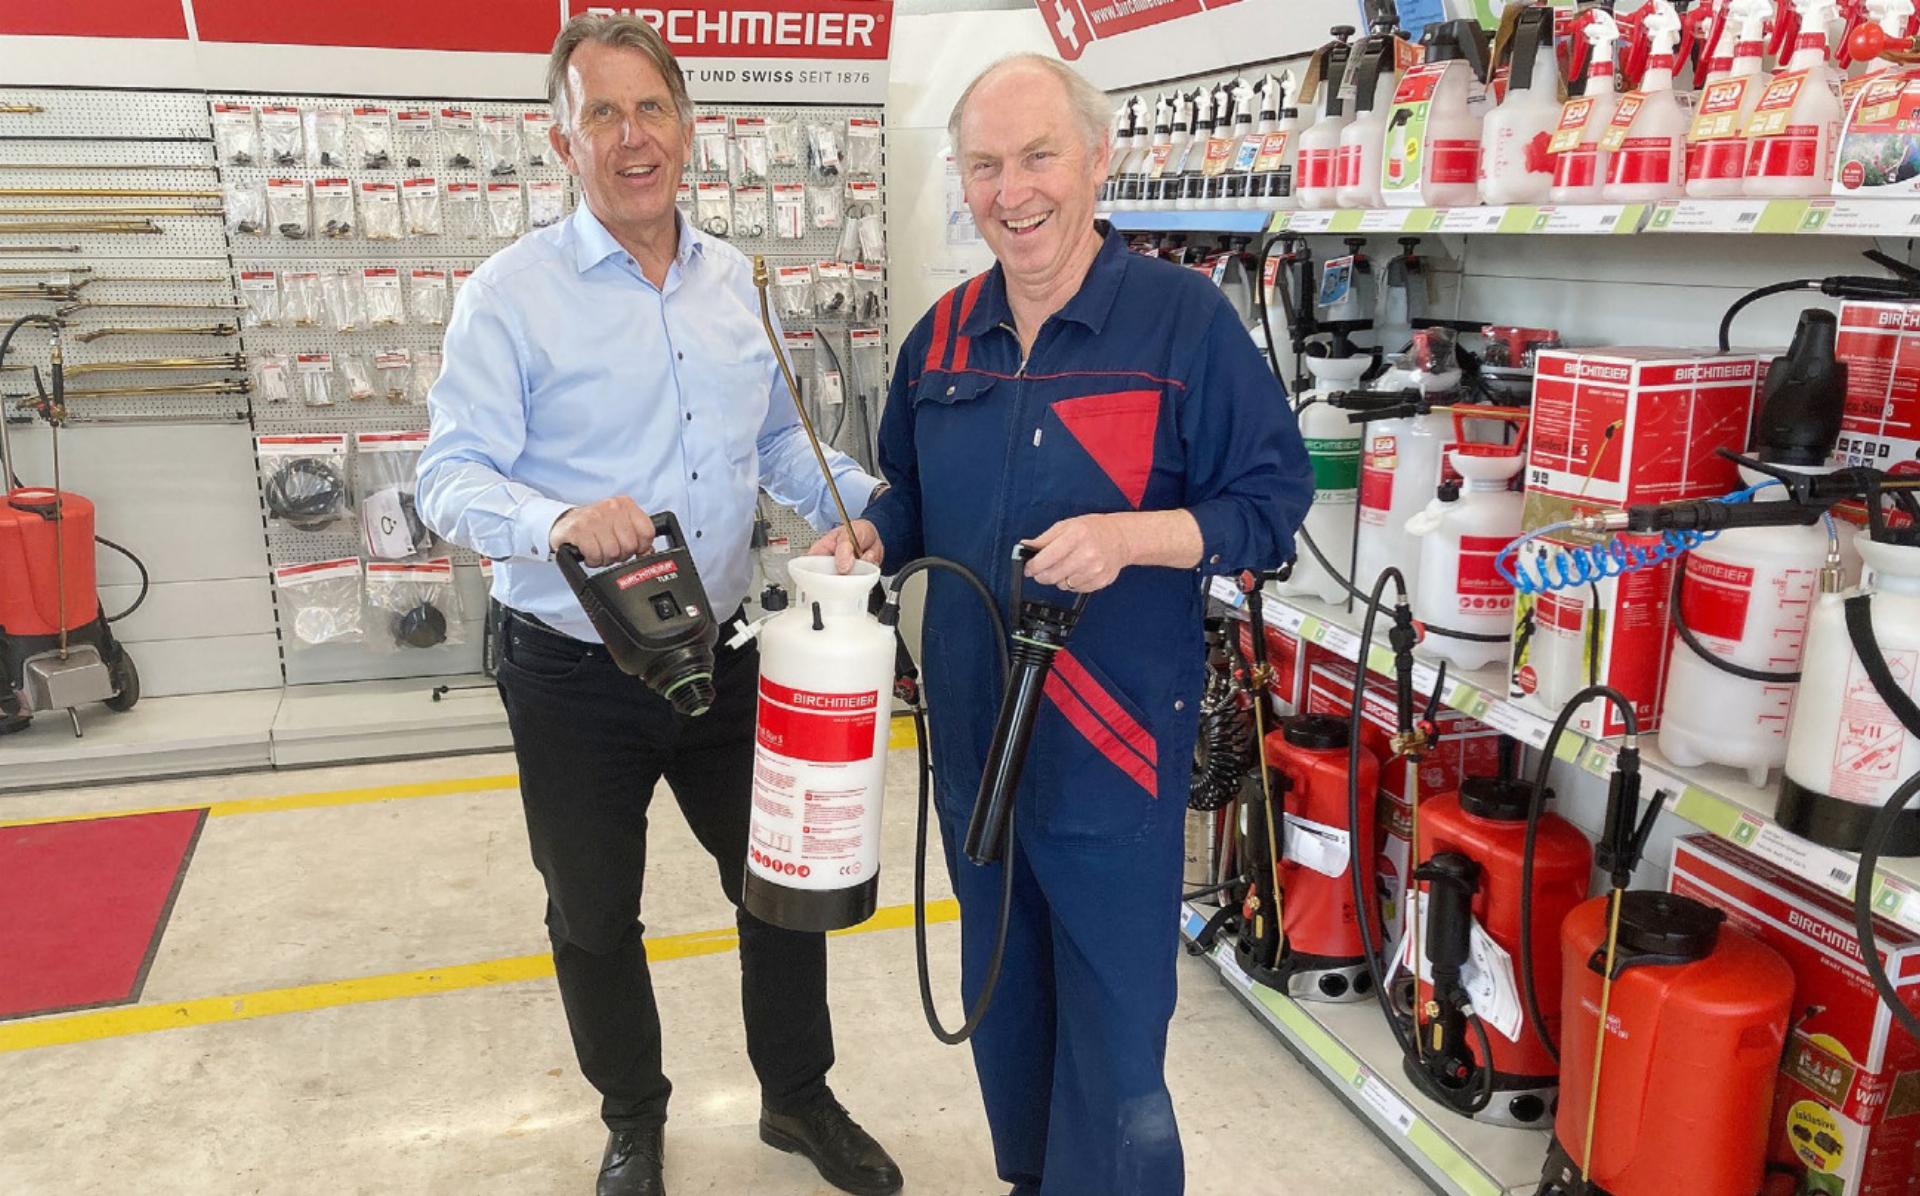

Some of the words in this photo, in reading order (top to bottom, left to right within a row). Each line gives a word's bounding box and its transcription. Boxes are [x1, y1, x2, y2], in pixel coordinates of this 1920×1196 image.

[700, 70, 736, 82] UND
[742, 70, 794, 83] SWISS
[798, 71, 832, 83] SEIT
[837, 72, 870, 84] 1876
[1564, 362, 1628, 380] BIRCHMEIER
[1675, 365, 1752, 380] BIRCHMEIER
[1580, 443, 1588, 457] 5
[793, 693, 875, 708] BIRCHMEIER
[1856, 1087, 1886, 1105] WIN
